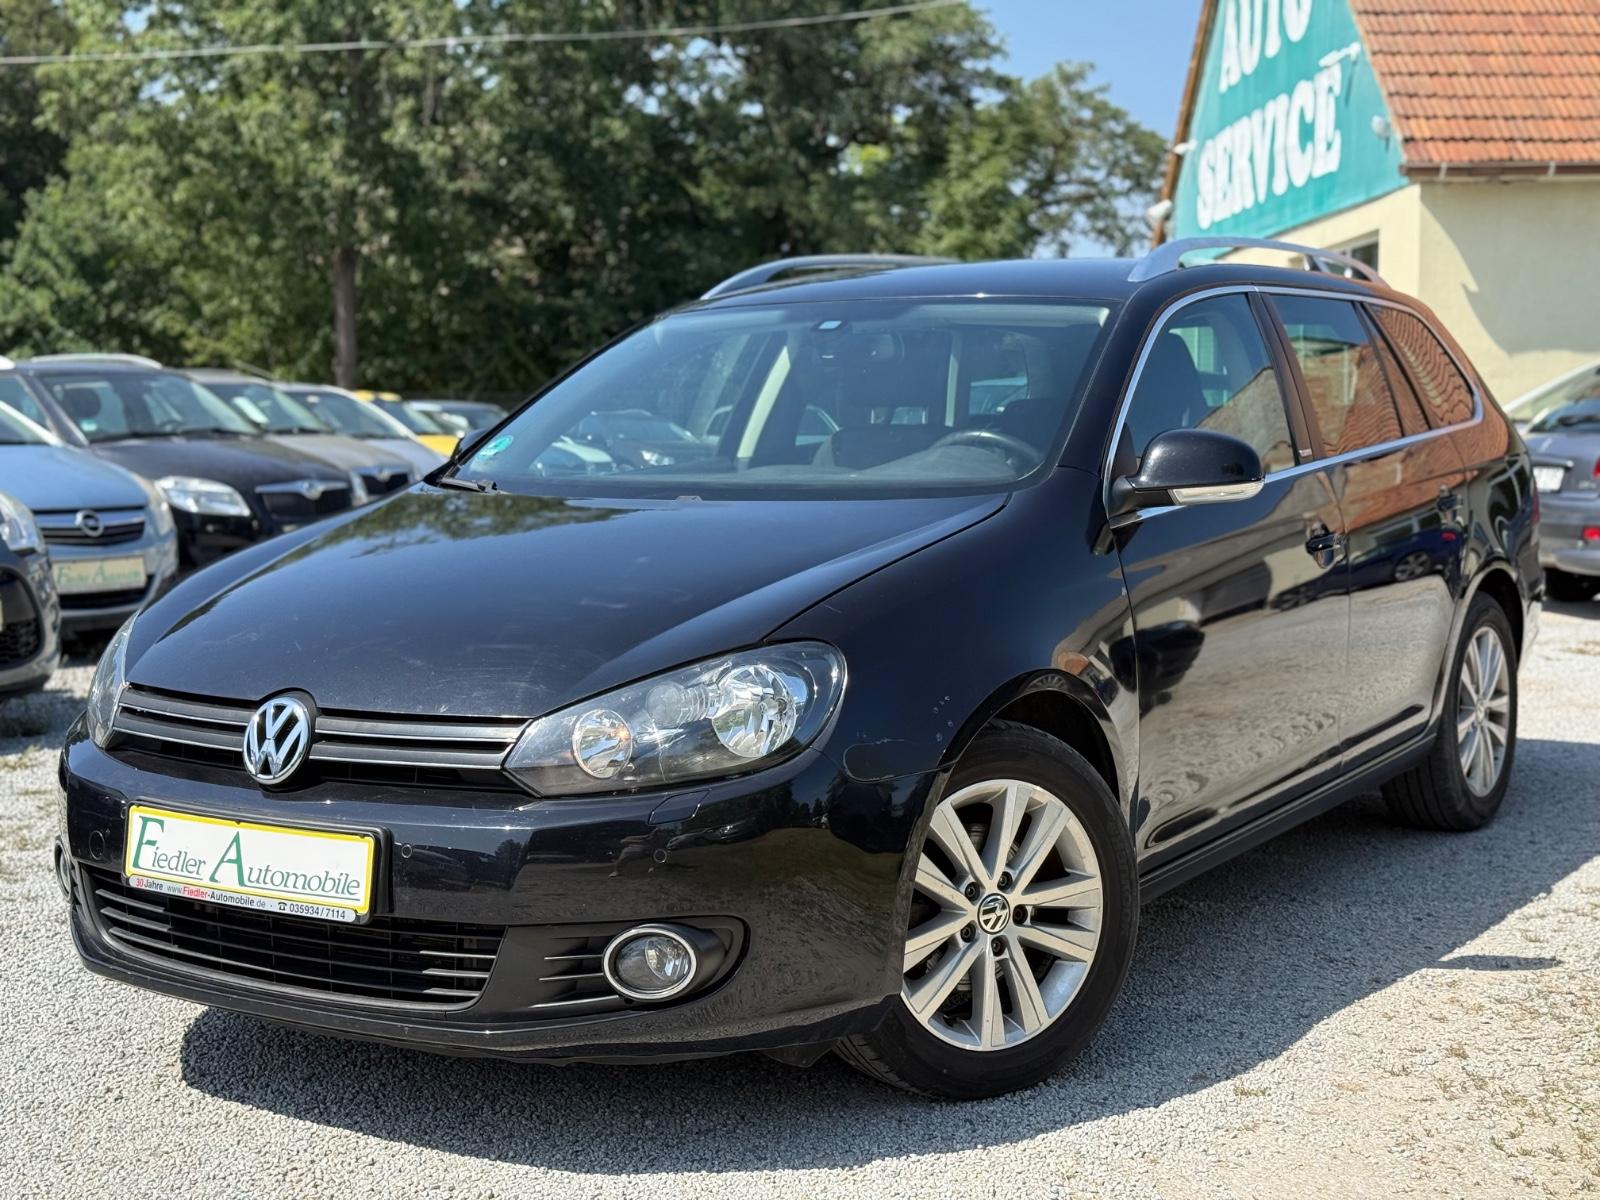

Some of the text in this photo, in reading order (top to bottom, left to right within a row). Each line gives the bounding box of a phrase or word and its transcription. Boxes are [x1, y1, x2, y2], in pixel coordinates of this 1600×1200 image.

[1197, 62, 1342, 230] SERVICE
[132, 815, 361, 896] Fiedler Automobile
[144, 879, 163, 890] Jahre
